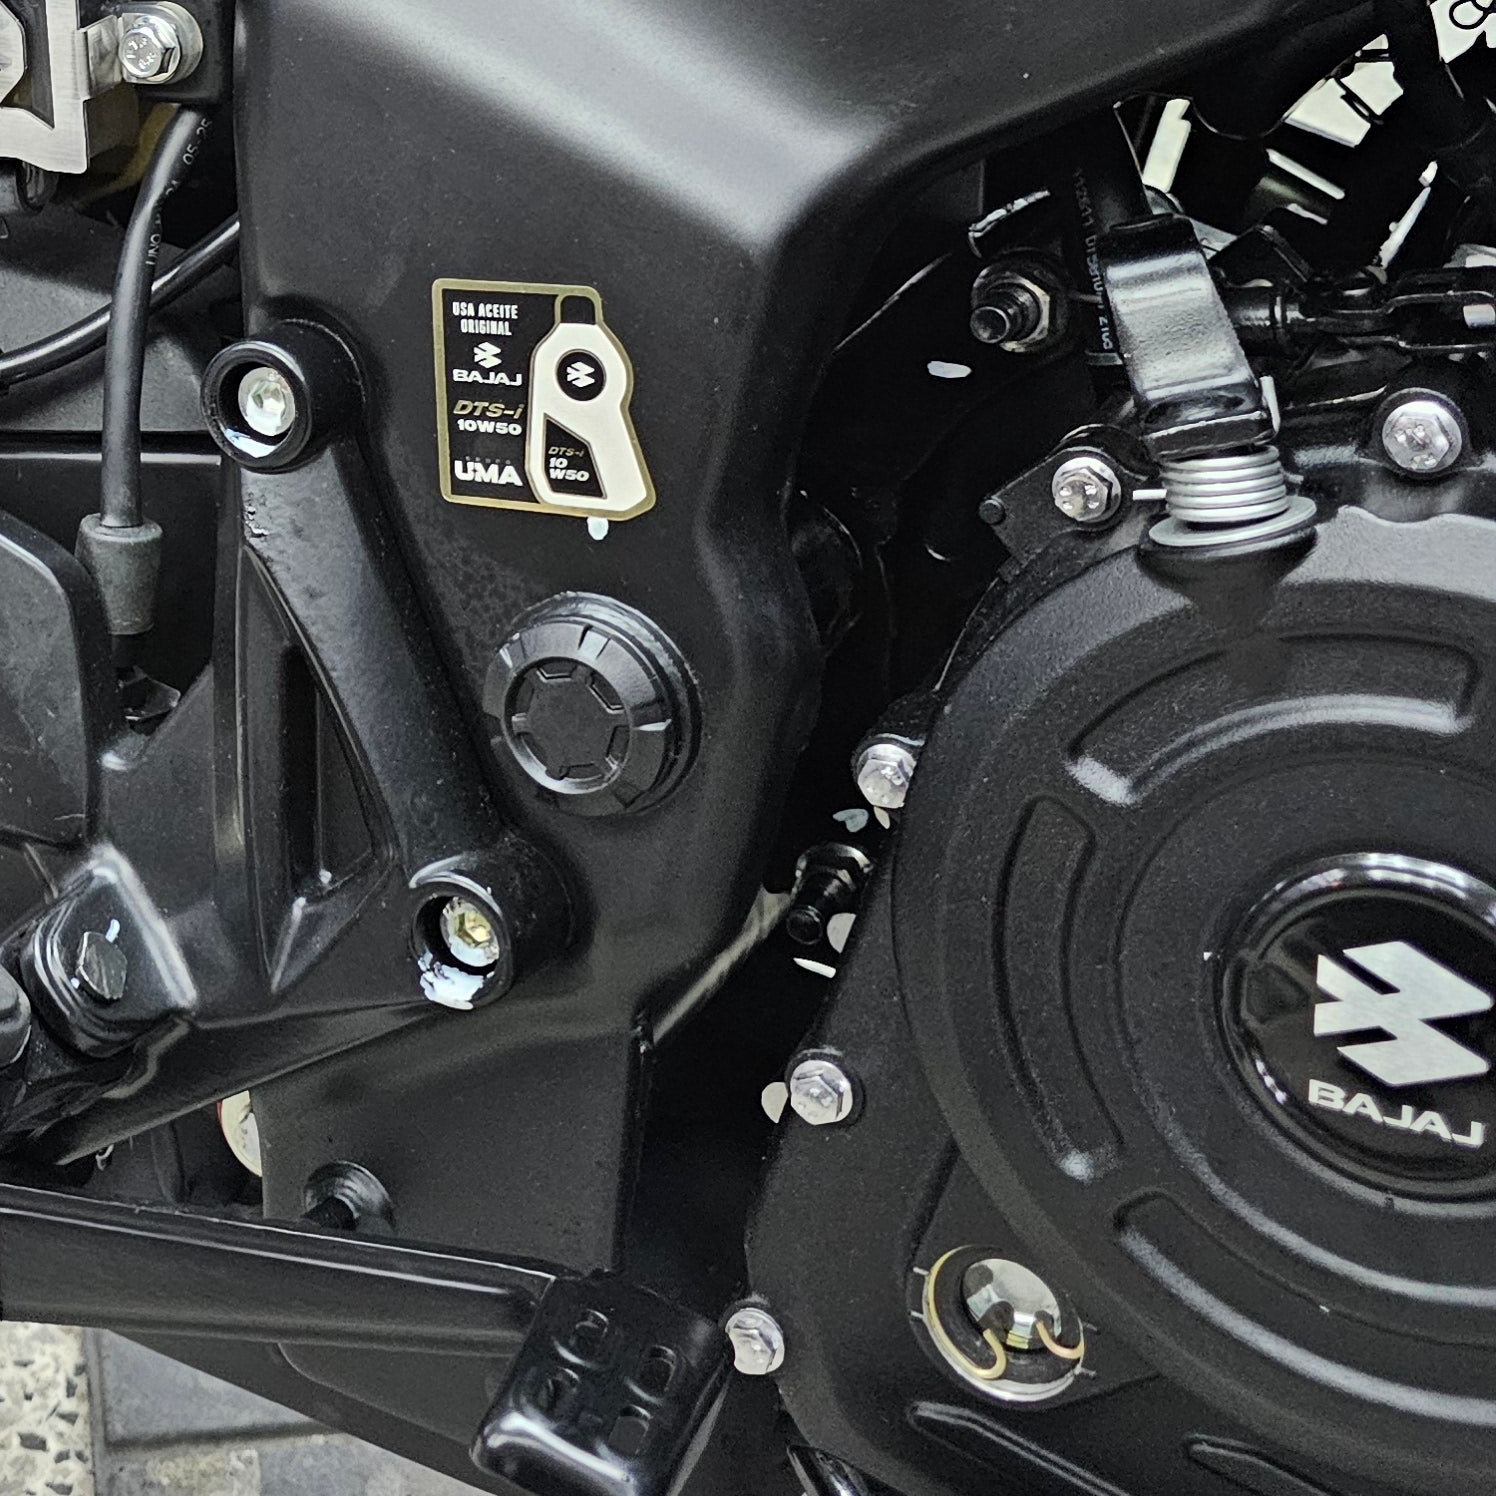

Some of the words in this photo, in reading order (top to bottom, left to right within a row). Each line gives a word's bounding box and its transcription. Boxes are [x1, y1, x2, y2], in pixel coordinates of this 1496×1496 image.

[452, 302, 475, 317] USA
[478, 304, 518, 319] ACEITE
[460, 319, 512, 336] ORIGINAL
[453, 369, 522, 386] BAJAJ
[453, 400, 525, 419] DTS-i
[457, 419, 522, 435] 10W50
[454, 460, 523, 486] UMA
[1309, 1079, 1486, 1148] BAJAJ
